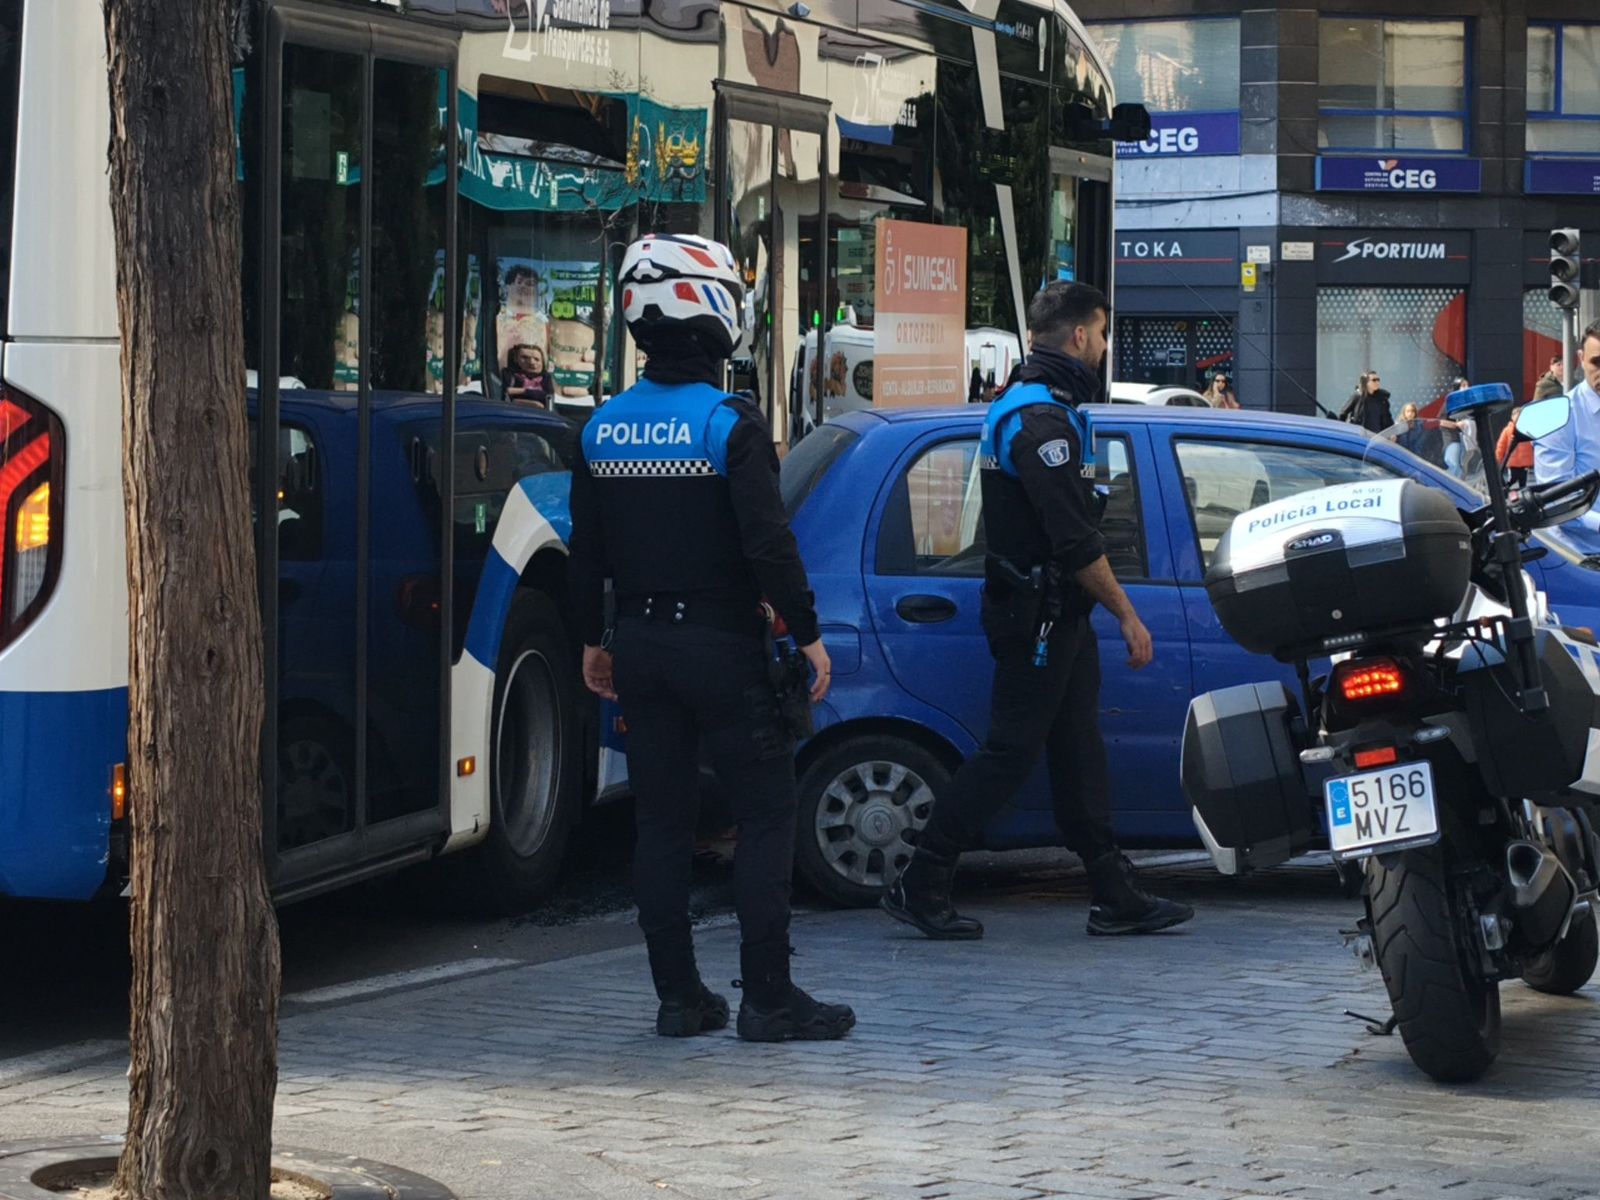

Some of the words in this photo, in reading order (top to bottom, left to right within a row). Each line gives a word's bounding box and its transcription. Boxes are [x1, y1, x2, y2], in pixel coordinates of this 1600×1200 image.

[544, 14, 594, 71] Transportes
[1140, 127, 1198, 153] CEG
[1389, 169, 1436, 188] CEG
[1121, 242, 1182, 257] TOKA
[1332, 237, 1445, 263] SPORTIUM
[904, 255, 958, 292] SUMESAL
[896, 322, 944, 345] ORTOPEDIA
[596, 417, 691, 445] POLICÍA
[1249, 504, 1317, 533] Policía
[1326, 495, 1382, 512] Local
[1352, 770, 1425, 808] 5166
[1336, 807, 1346, 818] E
[1355, 804, 1410, 840] MVZ
